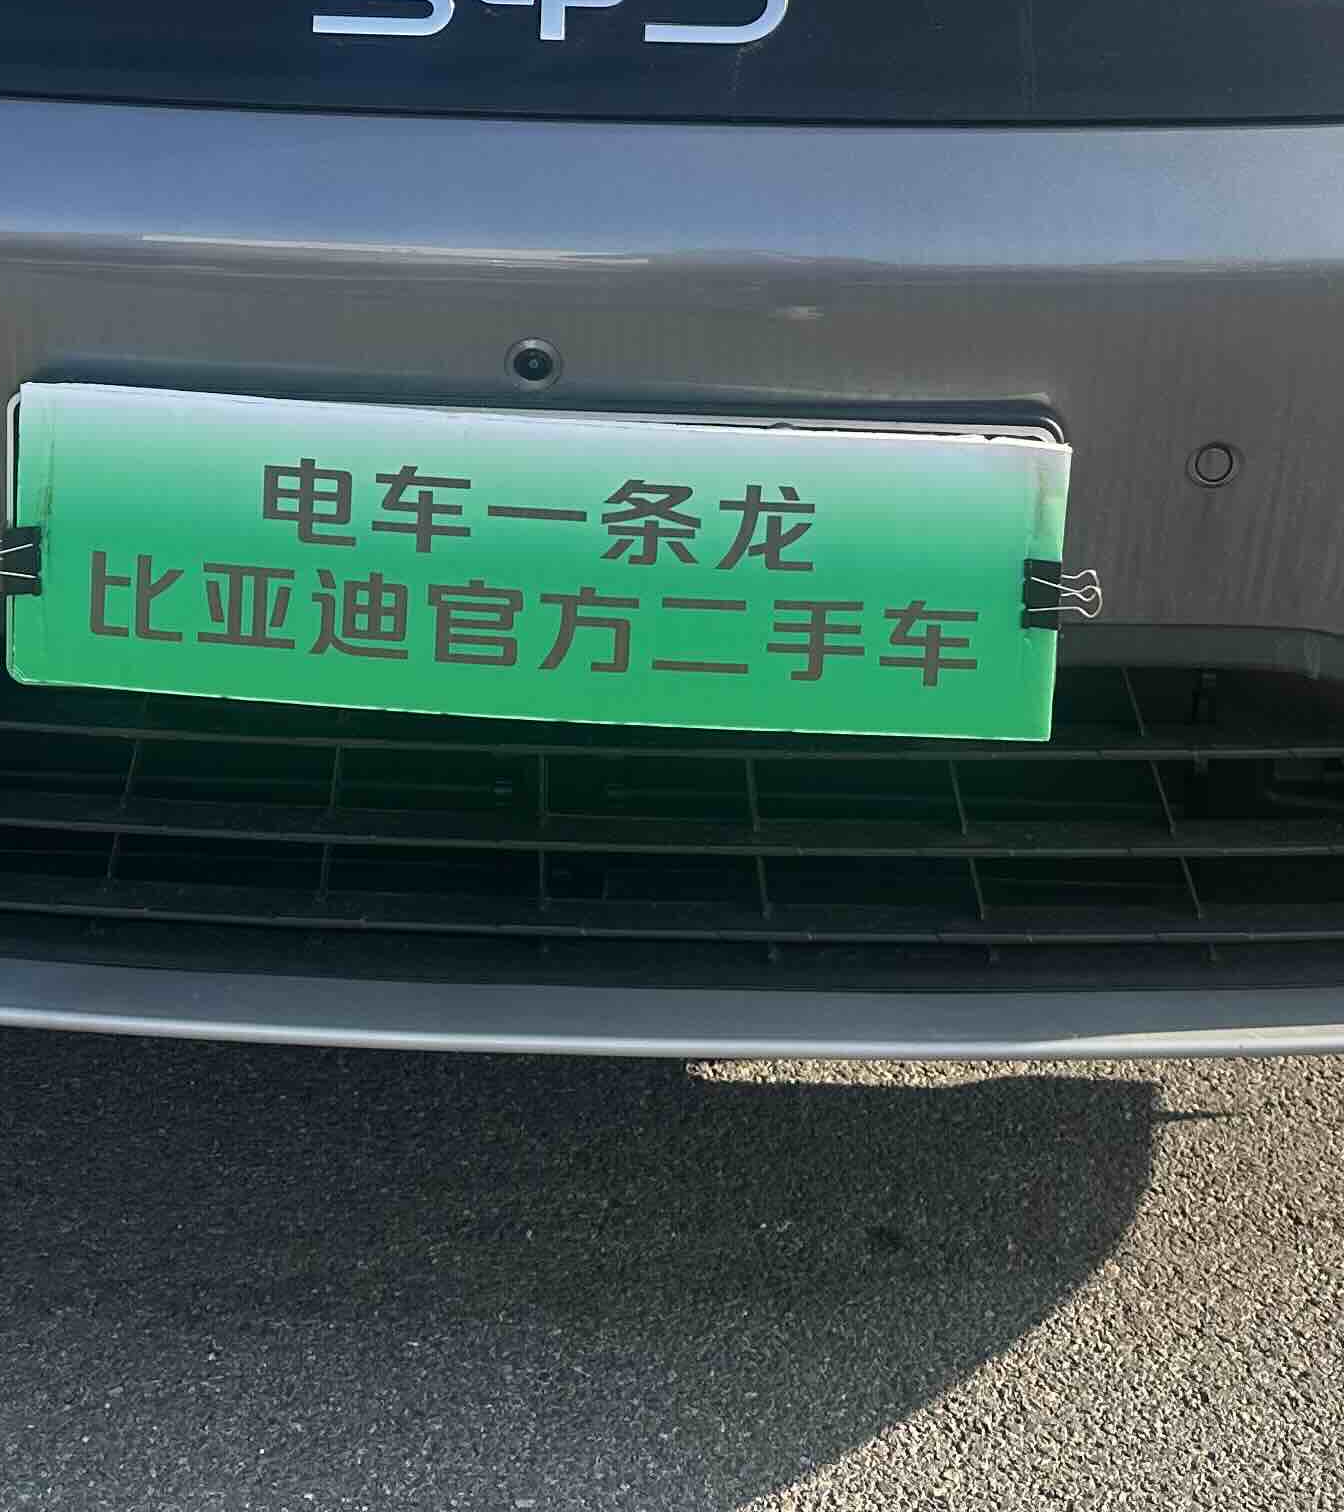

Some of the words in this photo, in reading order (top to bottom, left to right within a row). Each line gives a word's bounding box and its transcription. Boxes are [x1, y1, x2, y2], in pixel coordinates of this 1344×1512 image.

[261, 456, 818, 574] 电车一条龙
[88, 550, 980, 688] 比亚迪官方二手车
